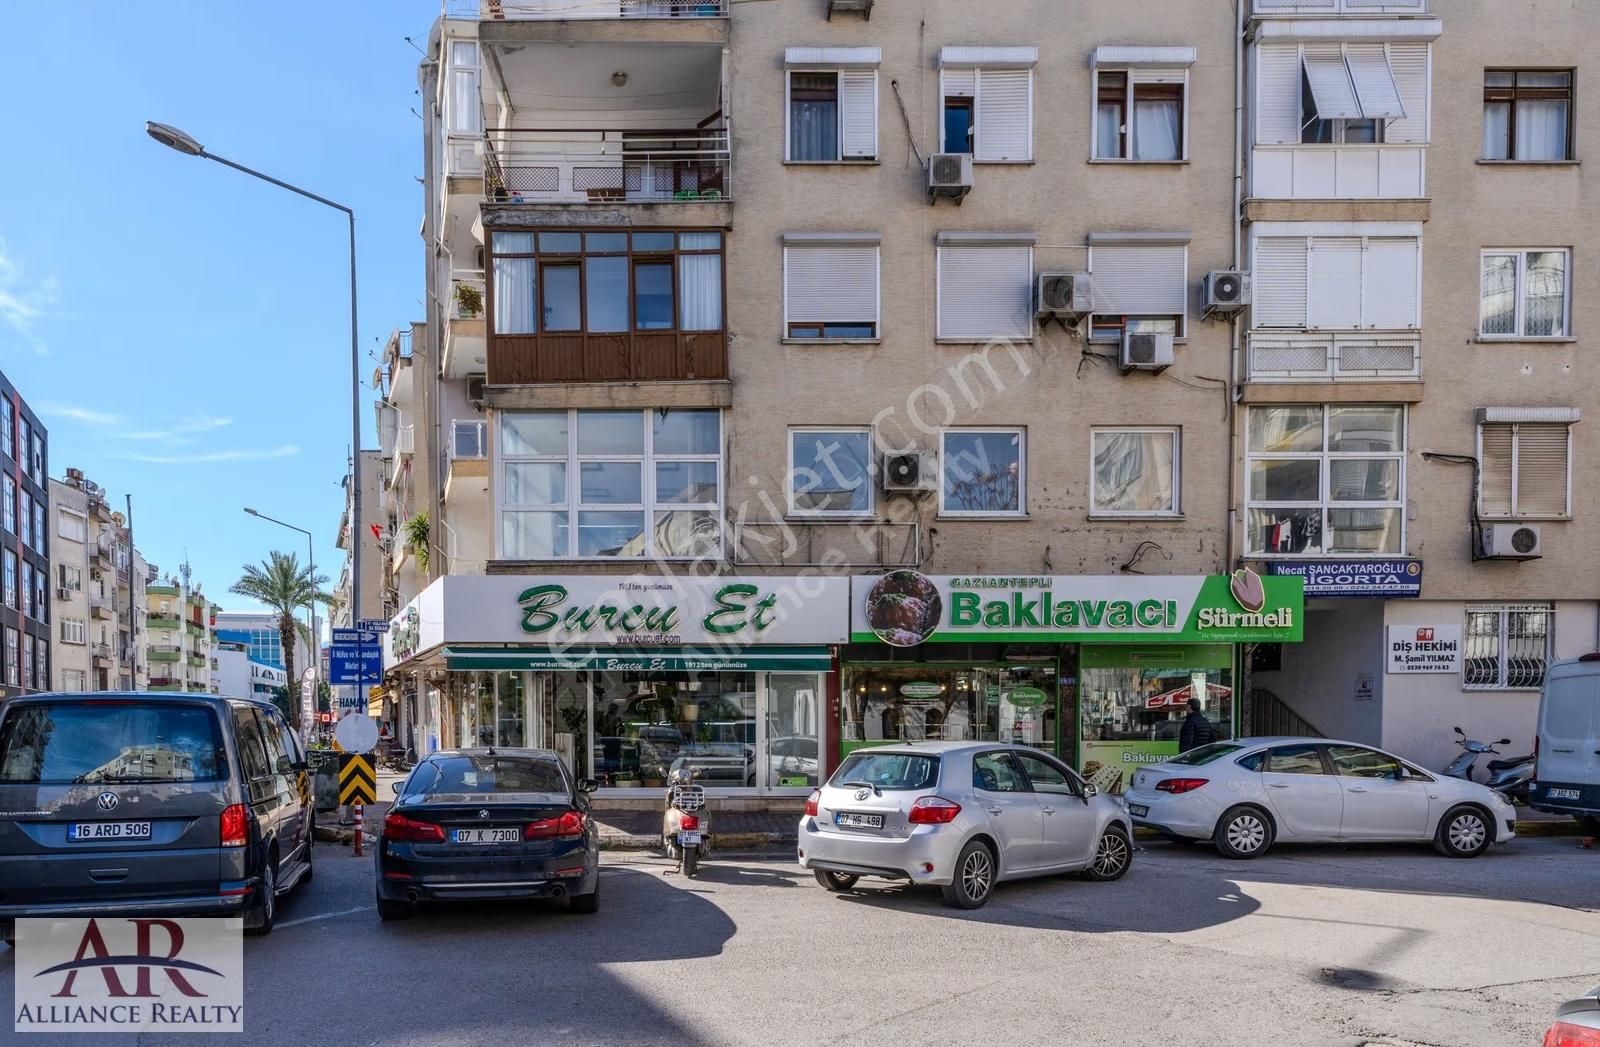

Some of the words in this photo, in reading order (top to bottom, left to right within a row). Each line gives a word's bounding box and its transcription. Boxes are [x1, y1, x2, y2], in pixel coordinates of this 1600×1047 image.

[1277, 565, 1306, 576] Necat
[1308, 562, 1405, 575] SANCAKTAROĞLU
[518, 584, 681, 634] Burcu
[702, 583, 777, 635] Et
[950, 591, 1178, 628] Baklavacı
[1198, 607, 1293, 630] Sürmeli
[616, 633, 681, 643] www.burcuet.com
[1393, 640, 1412, 653] DİŞ
[1415, 640, 1457, 652] HEKİMİ
[530, 660, 587, 668] www.burcuet.com
[606, 659, 644, 671] Burcu
[650, 658, 667, 670] Et
[712, 661, 748, 670] günümüze
[1405, 654, 1426, 664] Şamil
[1426, 654, 1455, 662] YILMAZ
[840, 814, 849, 823] 07
[867, 816, 881, 826] 498
[77, 825, 91, 837] 16
[95, 824, 121, 836] ARD
[125, 823, 149, 835] 506
[459, 830, 471, 841] 07
[477, 830, 484, 841] K
[492, 830, 518, 841] 7300
